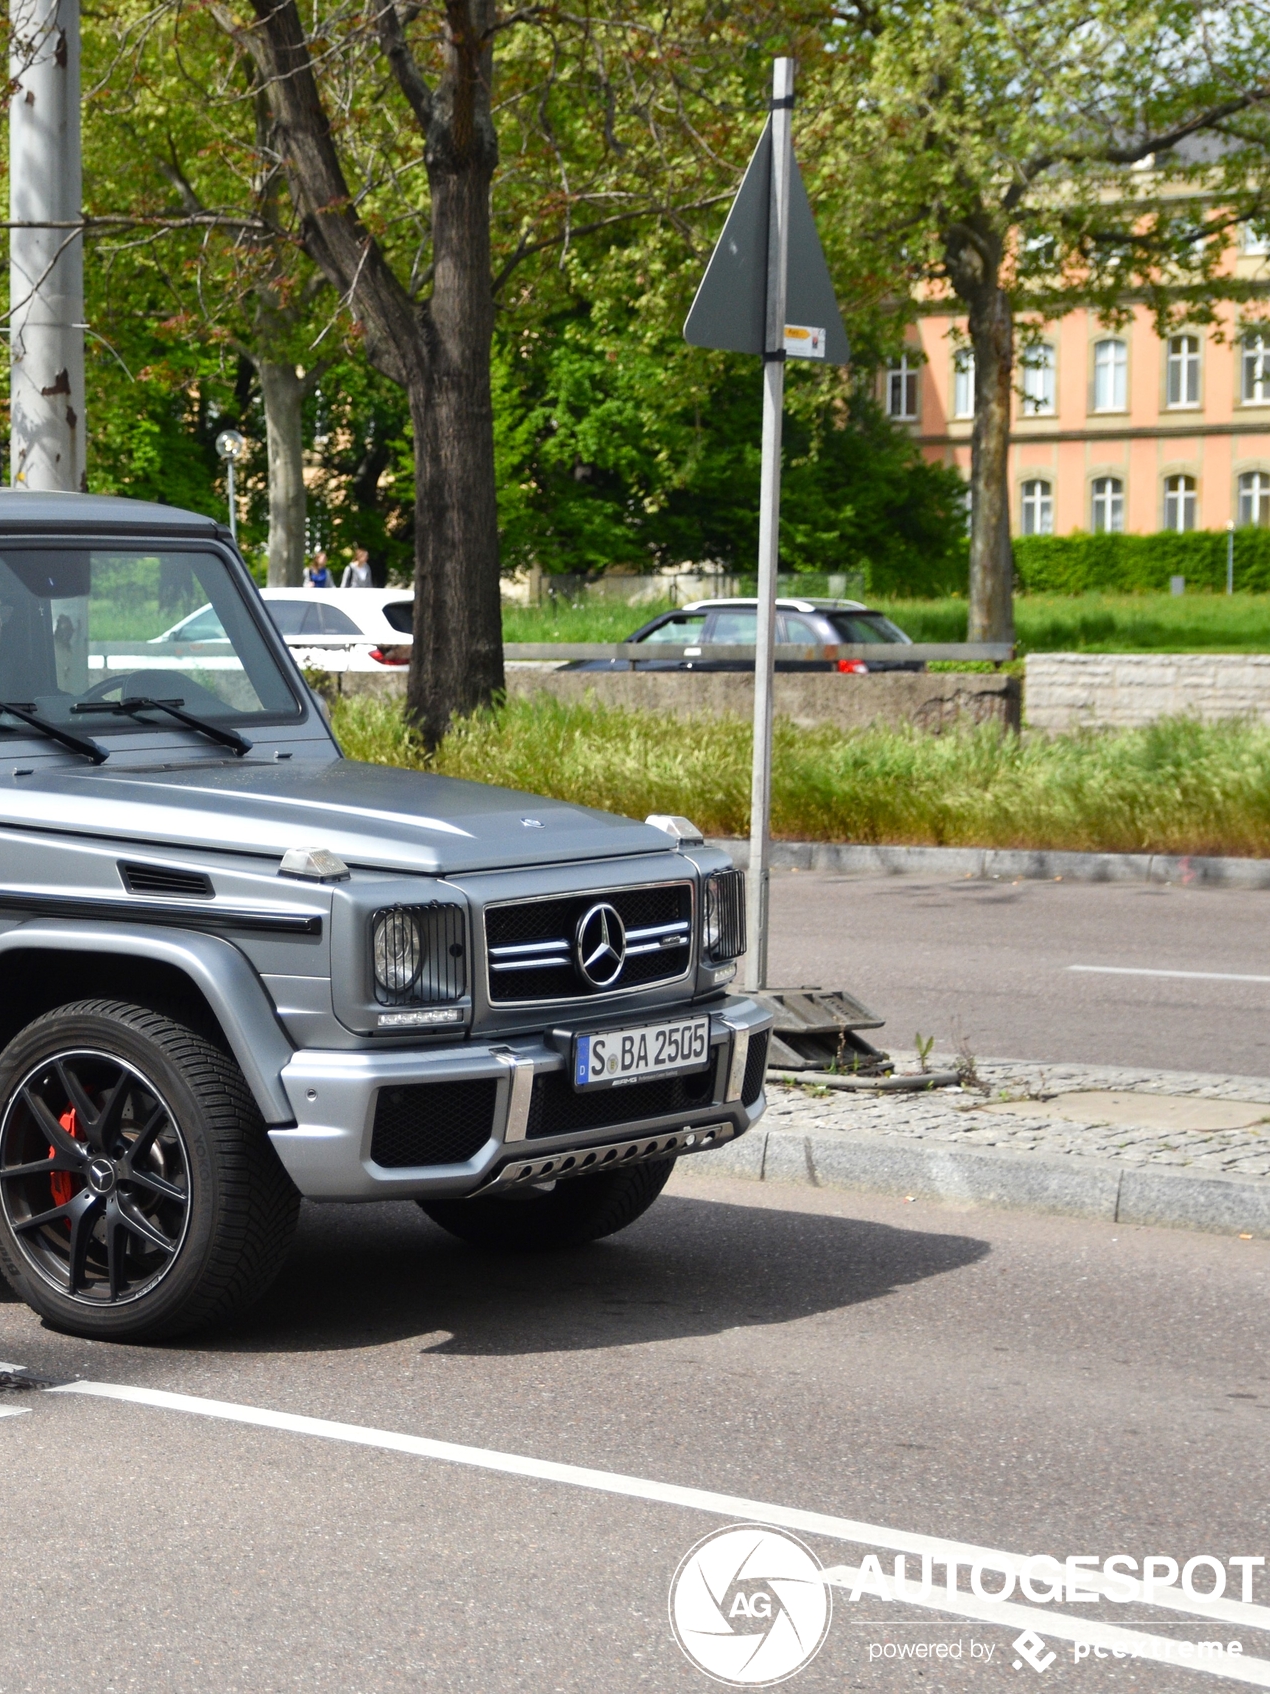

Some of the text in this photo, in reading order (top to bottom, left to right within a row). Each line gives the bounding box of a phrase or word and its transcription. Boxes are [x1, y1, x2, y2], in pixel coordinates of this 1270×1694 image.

[591, 1023, 706, 1076] S BA 2505
[580, 1065, 585, 1076] D
